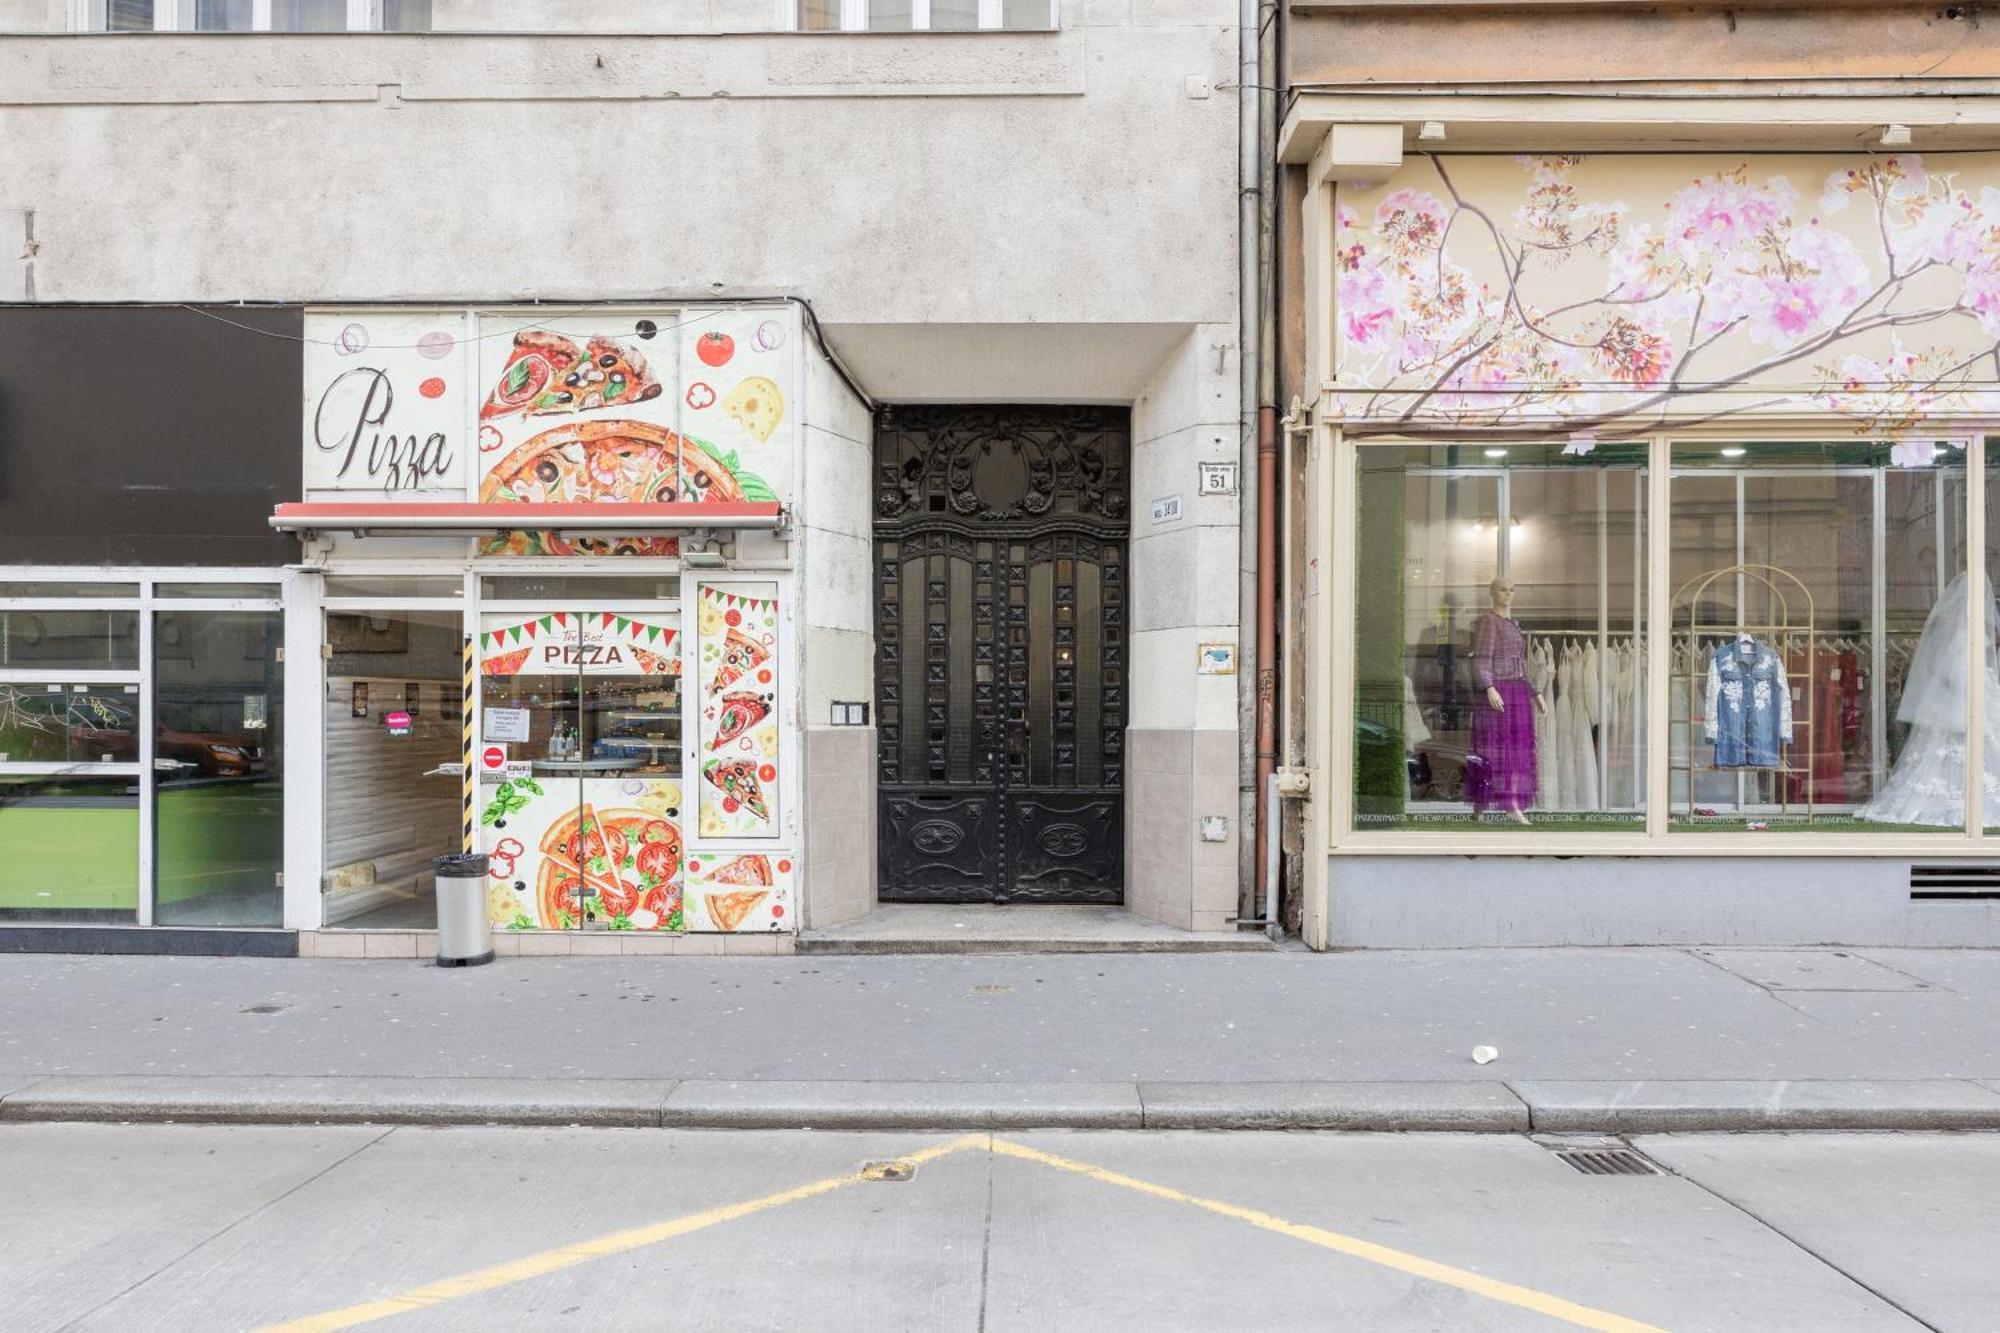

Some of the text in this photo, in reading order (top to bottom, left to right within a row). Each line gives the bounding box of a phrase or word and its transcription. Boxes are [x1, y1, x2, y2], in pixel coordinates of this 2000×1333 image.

[314, 367, 454, 490] Pizza
[1210, 474, 1225, 489] 51
[563, 630, 577, 641] The
[544, 645, 623, 665] PIZZA
